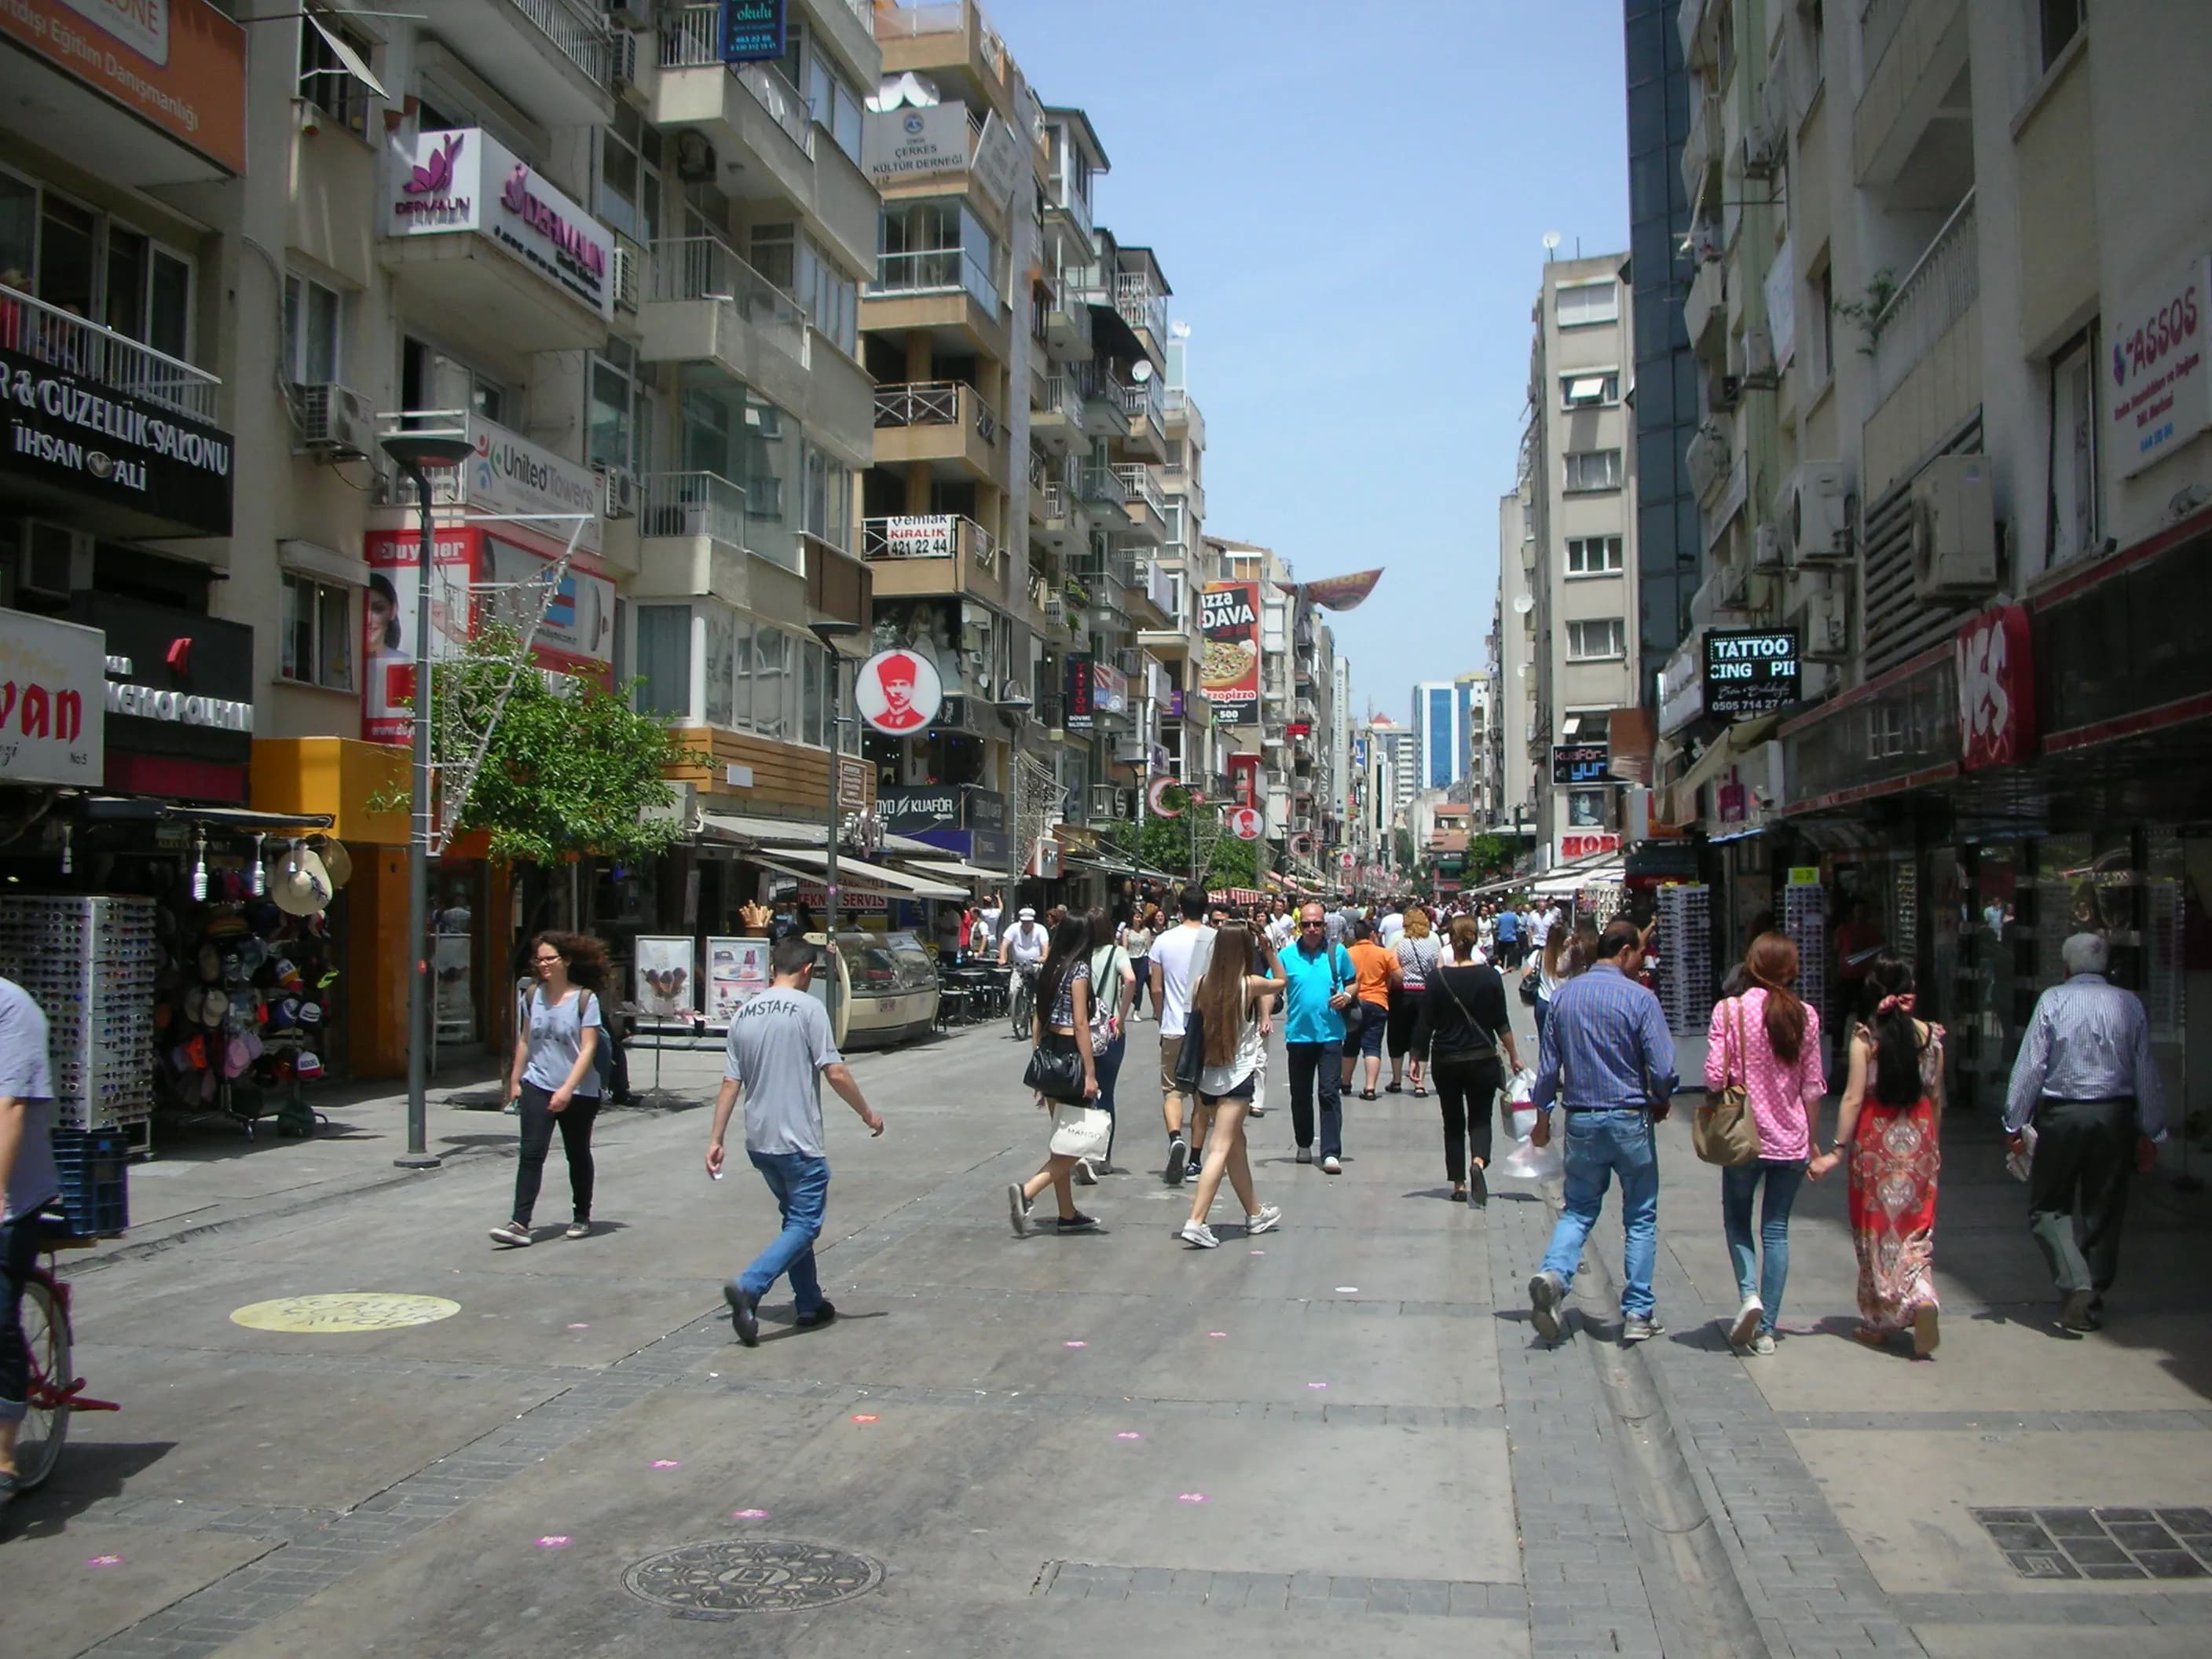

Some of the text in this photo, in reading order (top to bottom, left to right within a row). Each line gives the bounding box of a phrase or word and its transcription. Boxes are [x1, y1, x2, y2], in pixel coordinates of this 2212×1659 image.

[51, 20, 101, 68] Eğitim
[105, 52, 198, 131] Danışmanlığı
[873, 159, 914, 174] KÜLTÜR
[2133, 286, 2197, 377] ASSOS
[38, 376, 149, 449] GÜZELLİK
[148, 419, 229, 476] SALONU
[11, 418, 83, 471] İHSAN
[113, 460, 147, 492] ALİ
[892, 538, 947, 555] 421 22 44
[1715, 638, 1789, 658] TATTOO
[1074, 662, 1086, 715] TATTOO
[1219, 709, 1239, 719] 500
[1712, 701, 1739, 711] 0505
[1742, 700, 1763, 709] 714
[1765, 699, 1779, 709] 27
[911, 797, 954, 813] KUAFÖR
[738, 999, 800, 1020] MSTAFF
